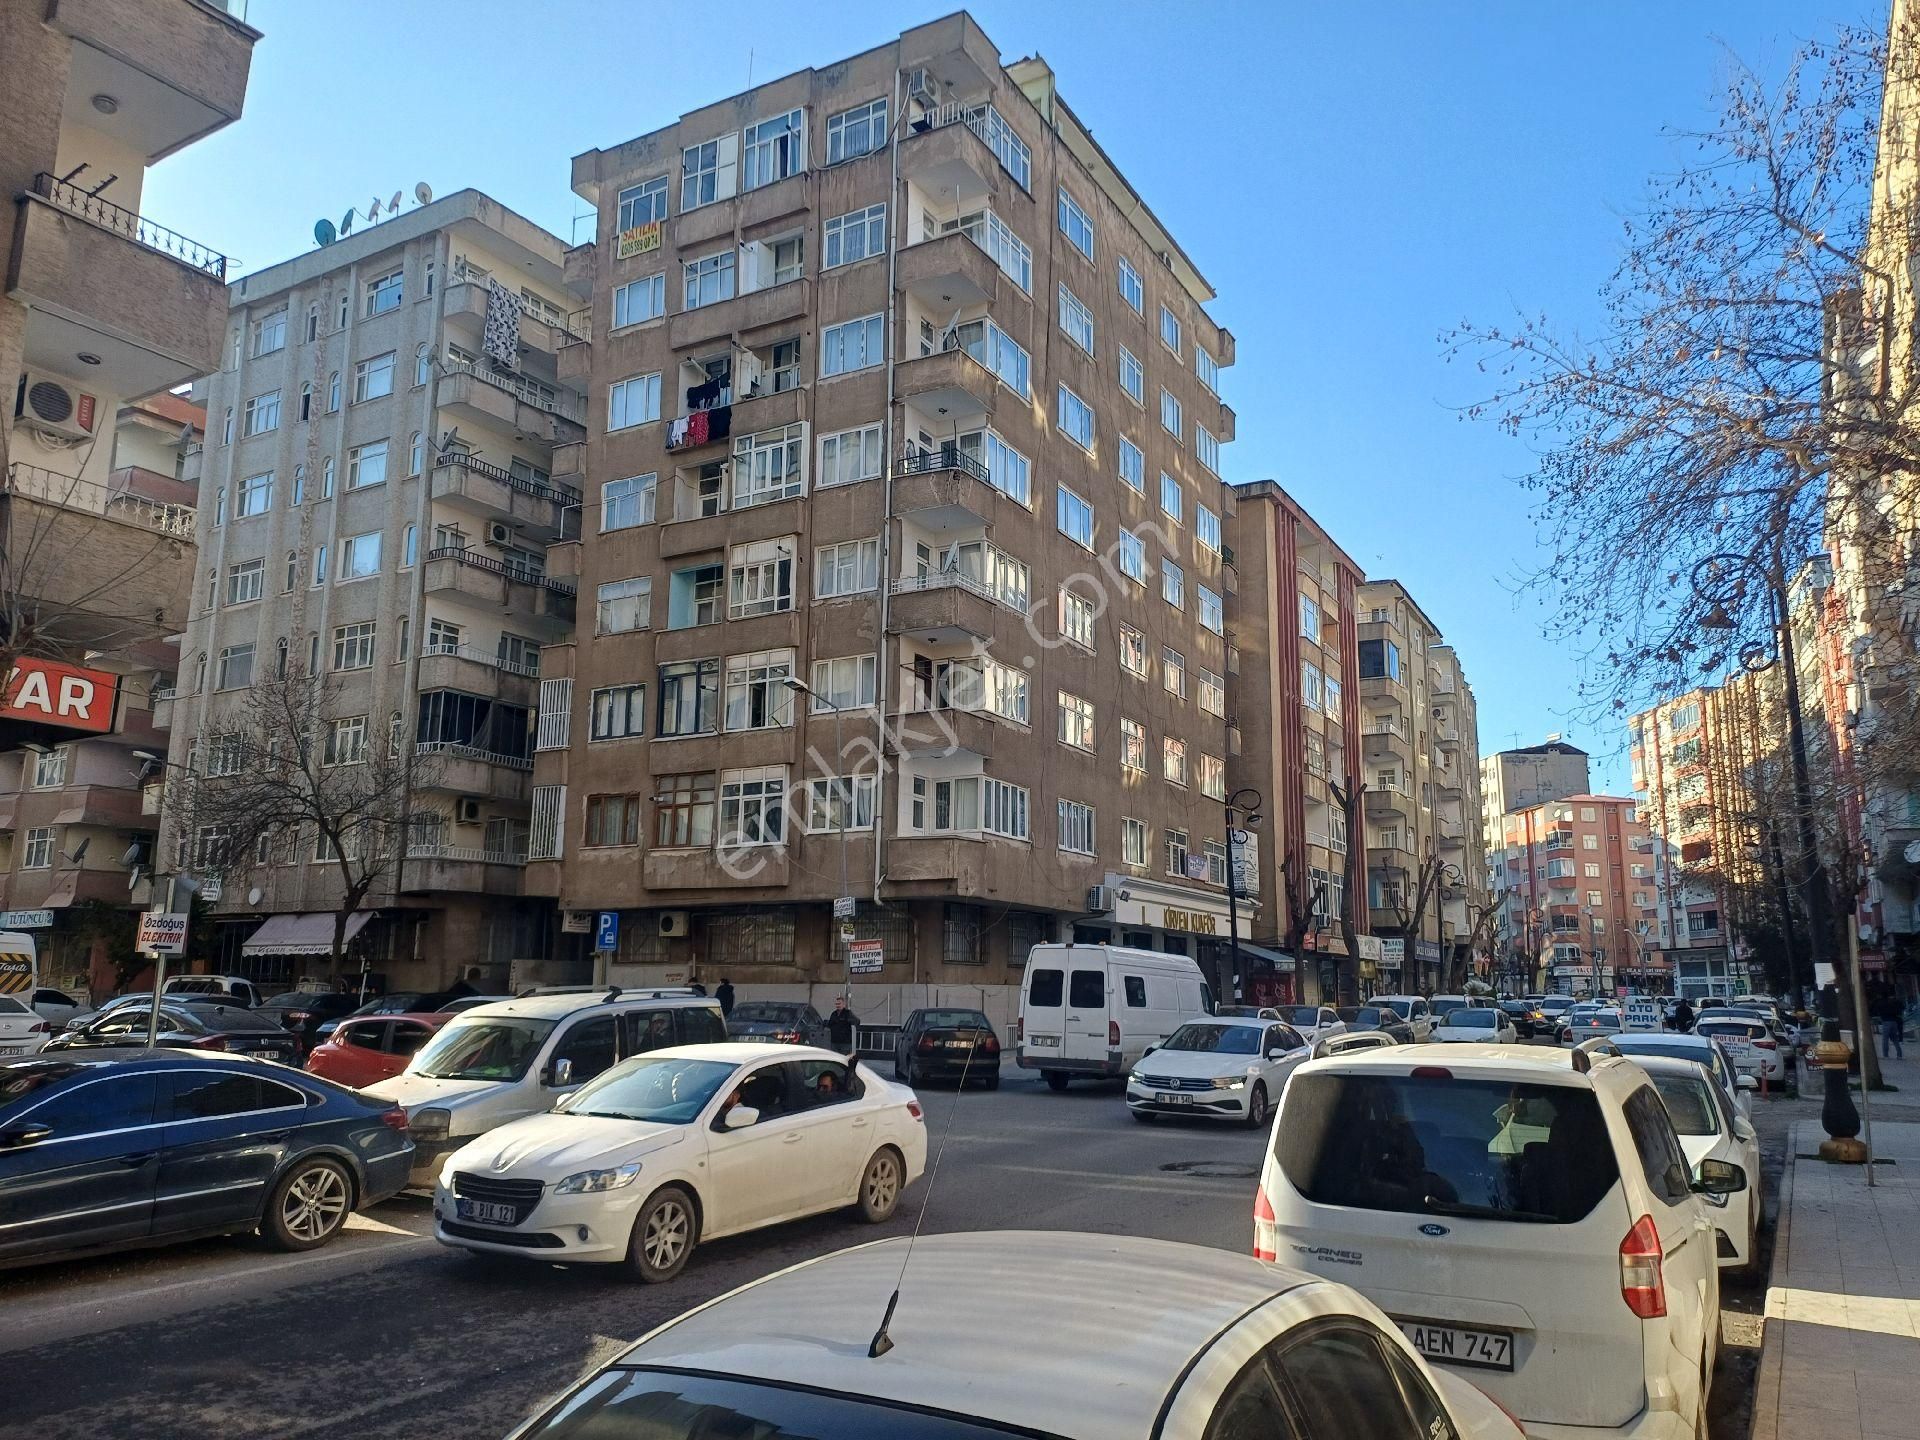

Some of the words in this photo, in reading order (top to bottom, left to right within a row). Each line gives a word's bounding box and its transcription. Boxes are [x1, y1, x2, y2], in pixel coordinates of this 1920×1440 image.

[601, 914, 612, 934] P
[1629, 1004, 1653, 1012] OTO
[1624, 1014, 1658, 1022] PARK
[1414, 1327, 1454, 1355] AEN
[1464, 1333, 1508, 1361] 747
